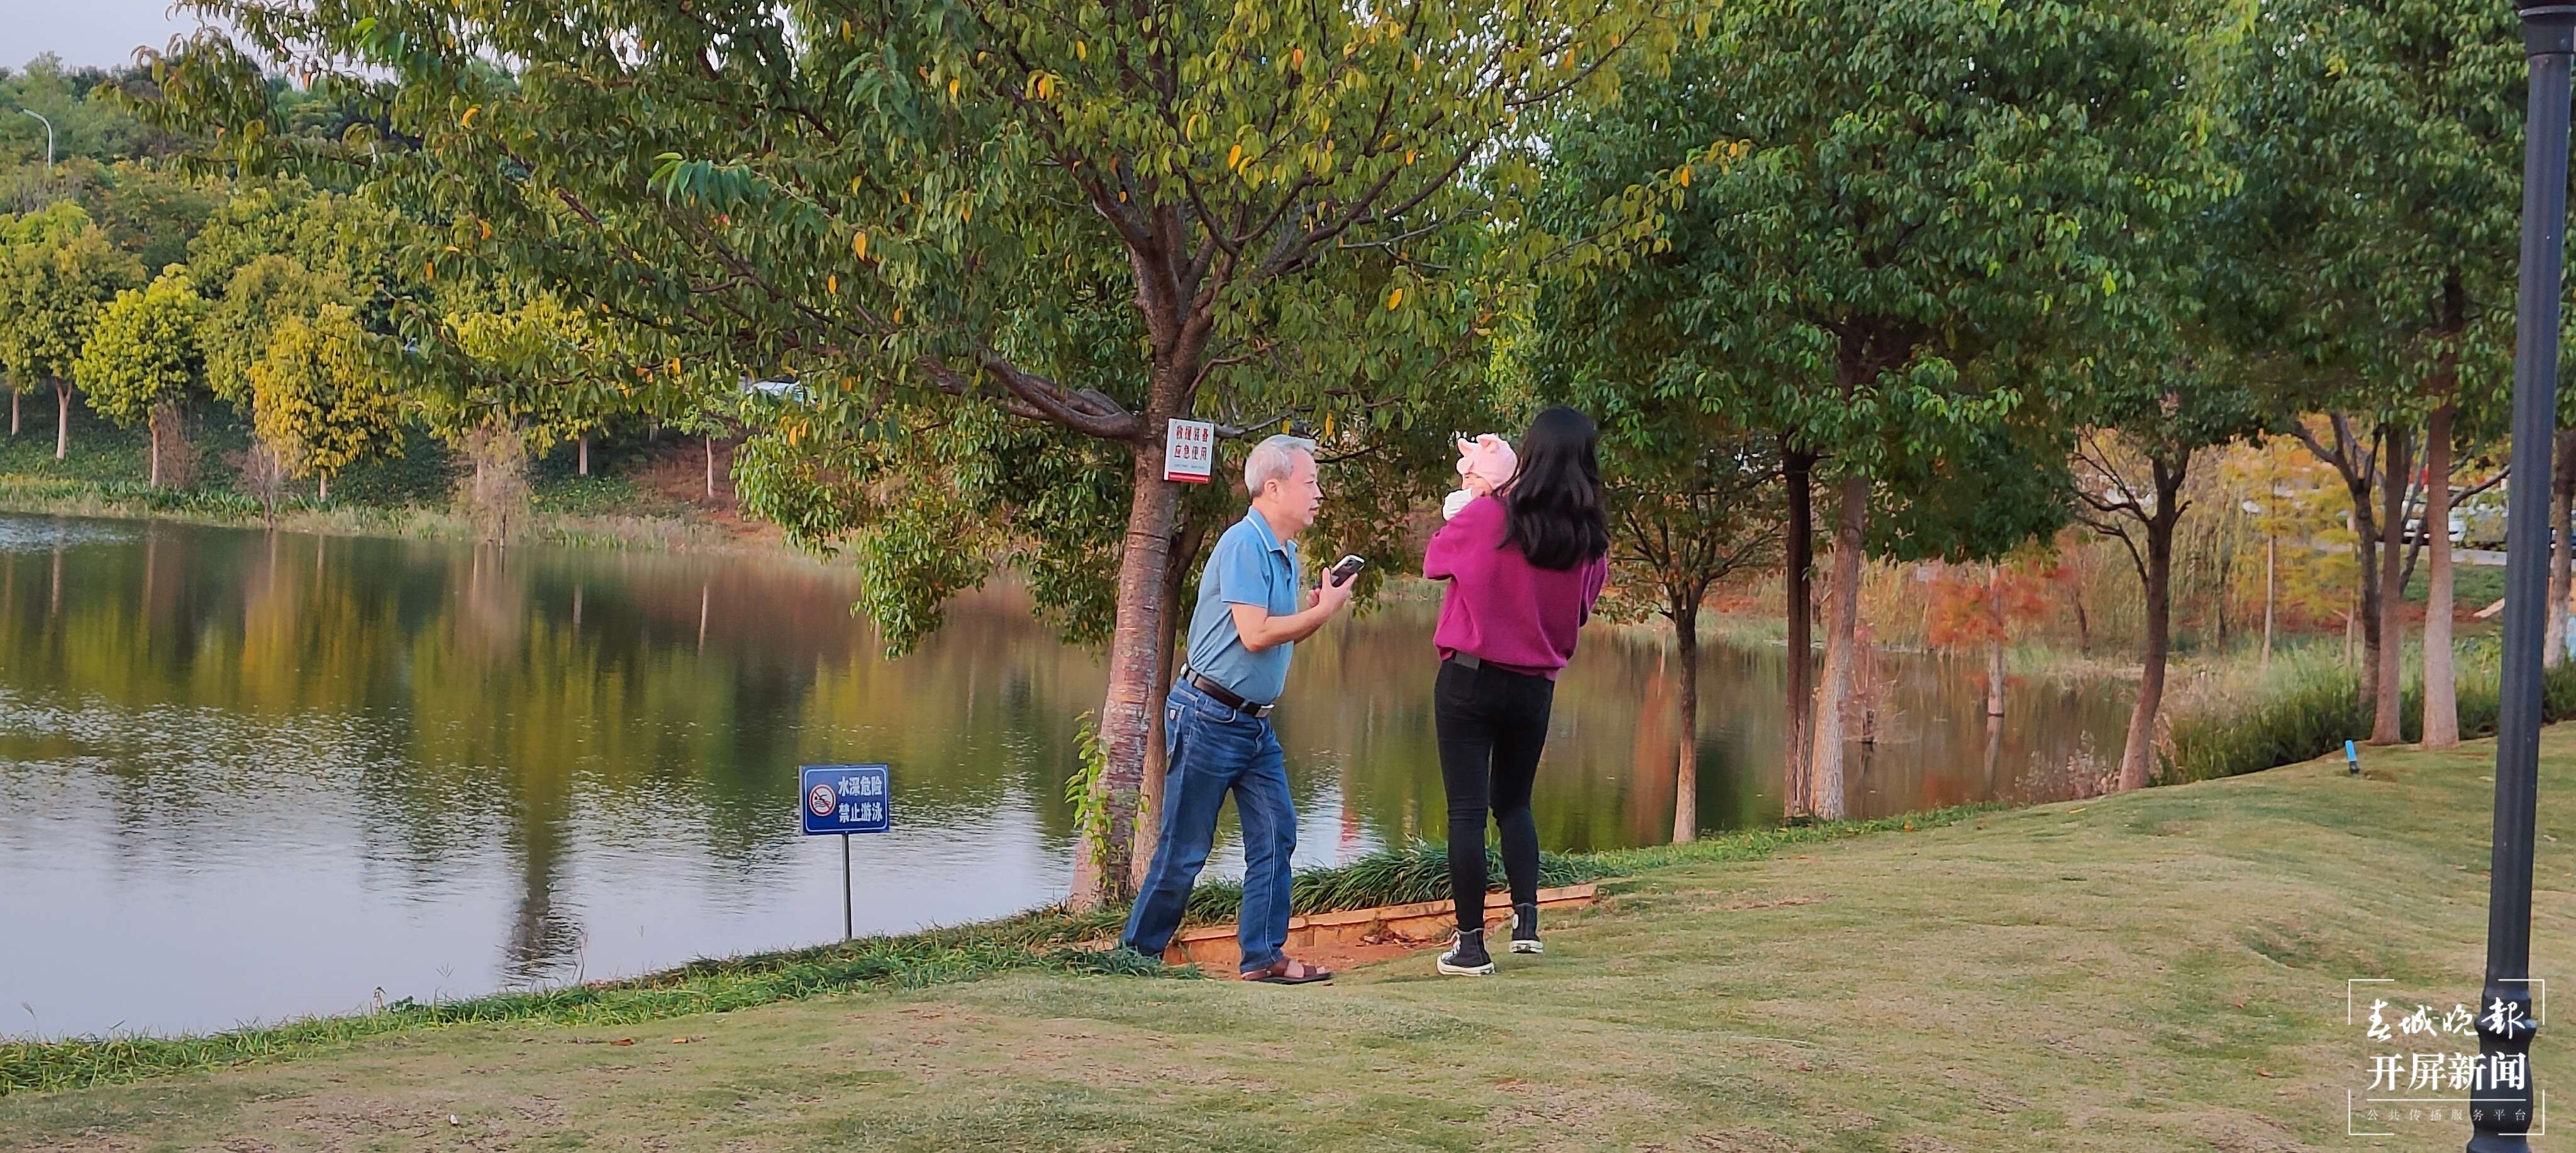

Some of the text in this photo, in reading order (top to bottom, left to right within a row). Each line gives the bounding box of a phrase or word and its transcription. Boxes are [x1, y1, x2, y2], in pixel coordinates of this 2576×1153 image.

[1174, 443, 1207, 461] 应急使用
[838, 775, 882, 797] 水深危险
[838, 802, 883, 824] 禁止游泳
